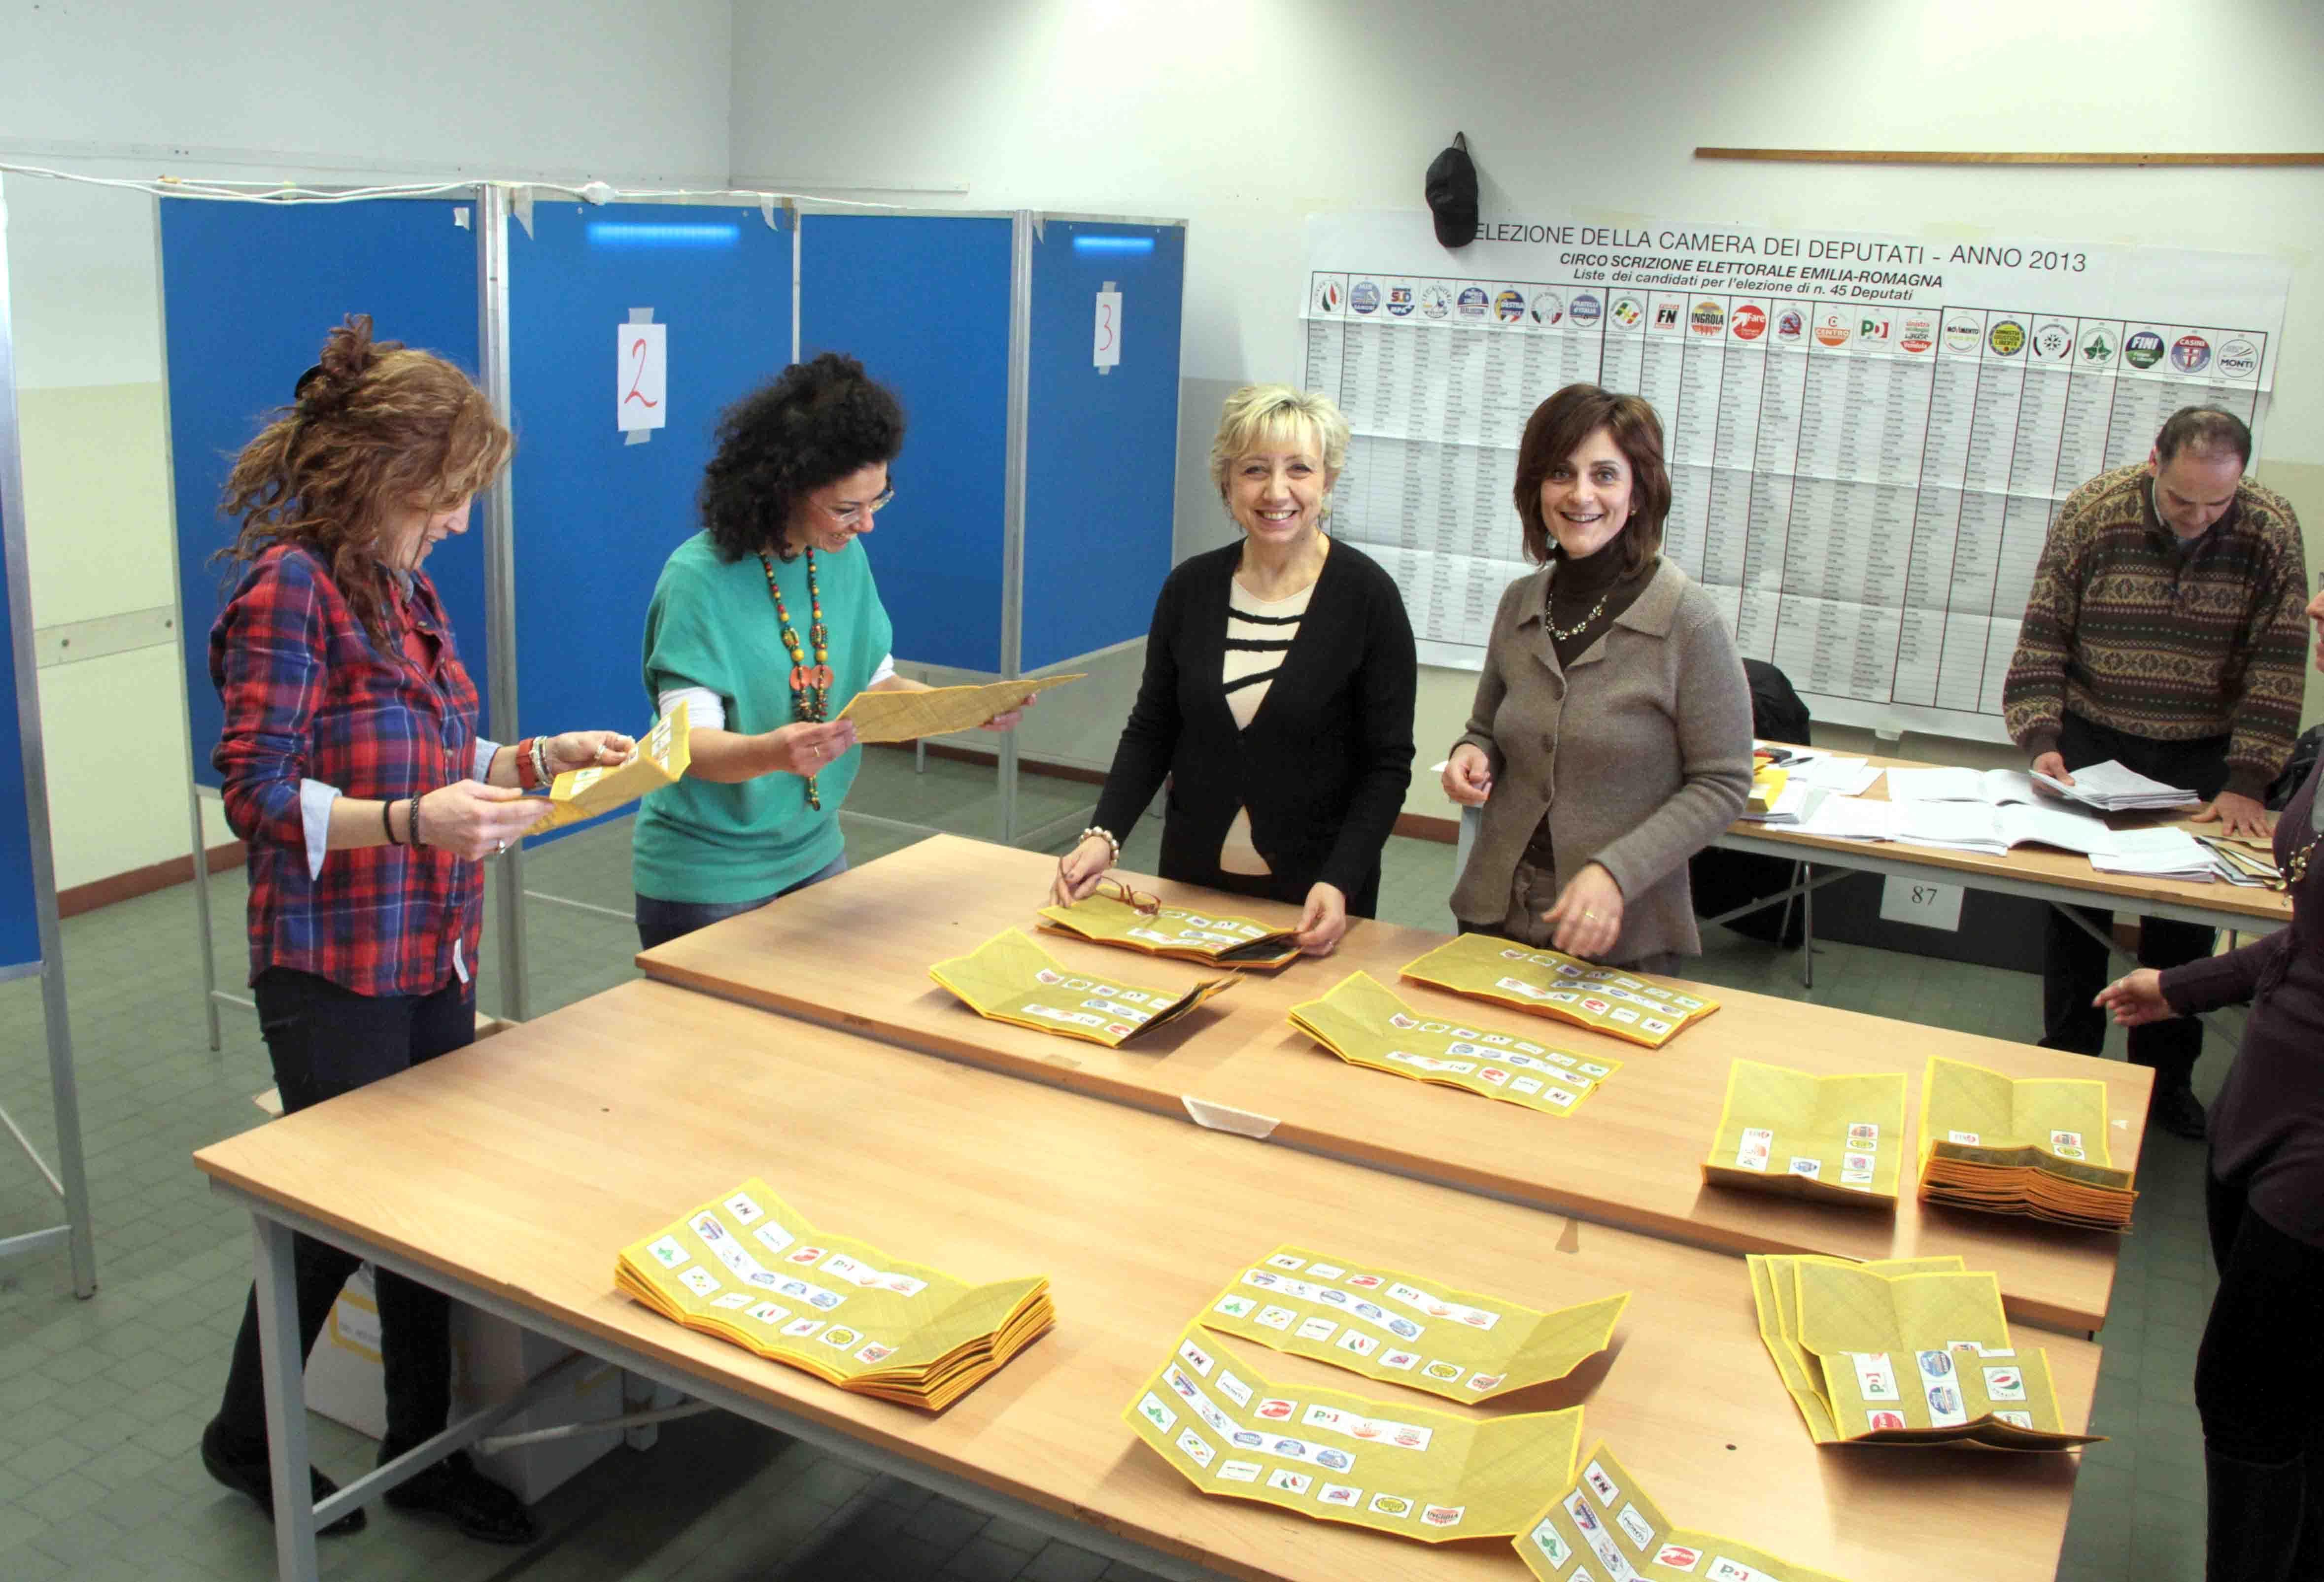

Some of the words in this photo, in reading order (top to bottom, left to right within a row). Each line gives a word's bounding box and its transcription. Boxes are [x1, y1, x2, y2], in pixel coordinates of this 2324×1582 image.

[1474, 223, 1574, 244] ELEZIONE
[1581, 227, 1652, 247] DELLA
[1659, 231, 1756, 254] CAMERA
[1764, 237, 1800, 257] DEI
[1809, 240, 1924, 265] DEPUTATI
[1949, 244, 2021, 267] ANNO
[2028, 250, 2086, 272] 2013
[1573, 269, 1605, 280] Liste
[1612, 271, 1632, 282] dei
[1635, 273, 1699, 286] candidati
[1701, 276, 1724, 288] per
[1728, 277, 1793, 292] l'elezione
[1797, 282, 1811, 293] di
[1813, 286, 1825, 294] n.
[1829, 284, 1847, 295] 45
[1851, 285, 1913, 301] Deputati
[1696, 260, 1798, 278] ELETTORALE
[1800, 266, 1943, 287] EMILIA-ROMAGNA
[1099, 304, 1112, 351] 3
[1657, 309, 1678, 323] FN
[1691, 312, 1724, 324] INGROIA
[2131, 337, 2159, 350] FINI
[624, 338, 658, 408] 2
[2220, 358, 2254, 369] MONTI
[1912, 886, 1937, 906] 87
